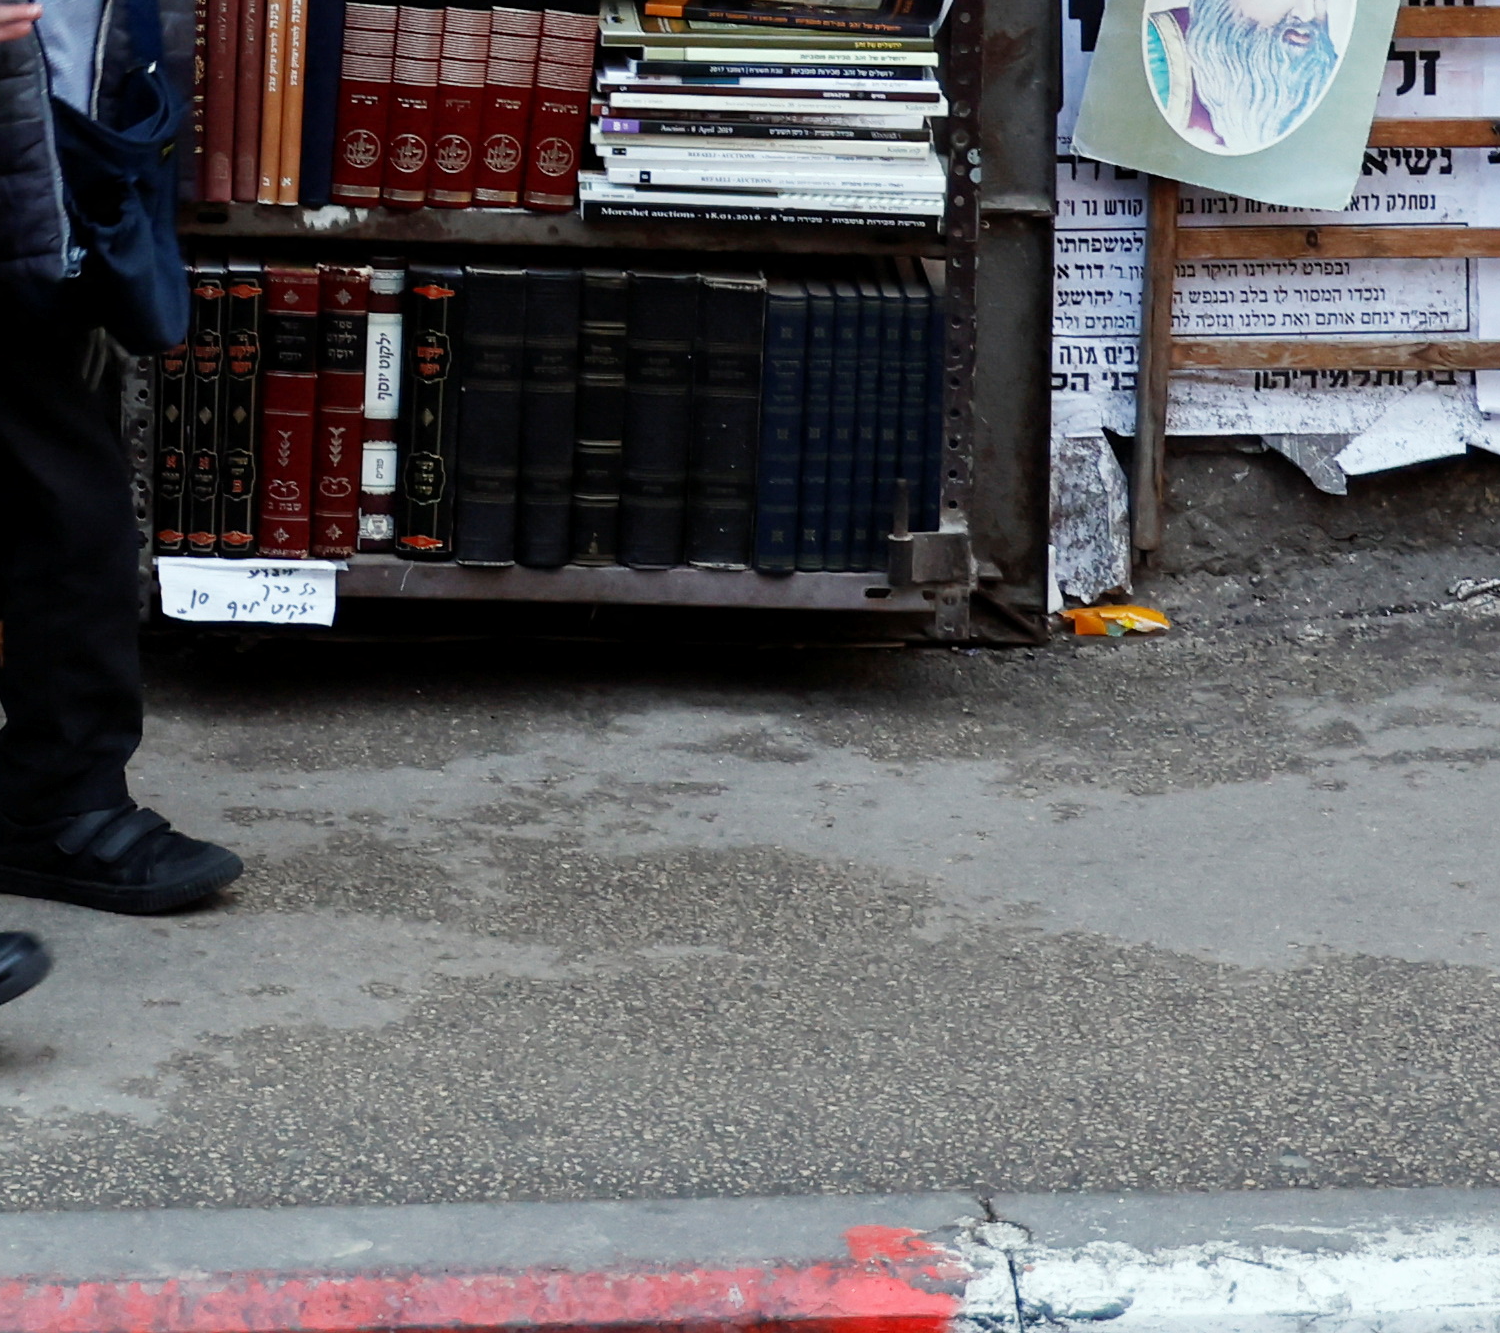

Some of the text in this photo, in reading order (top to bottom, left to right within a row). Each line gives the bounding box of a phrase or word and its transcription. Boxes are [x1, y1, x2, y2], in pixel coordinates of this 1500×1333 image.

[600, 206, 649, 218] Moreshet
[651, 209, 696, 220] auctions
[376, 332, 395, 402] ילקוט יוסף
